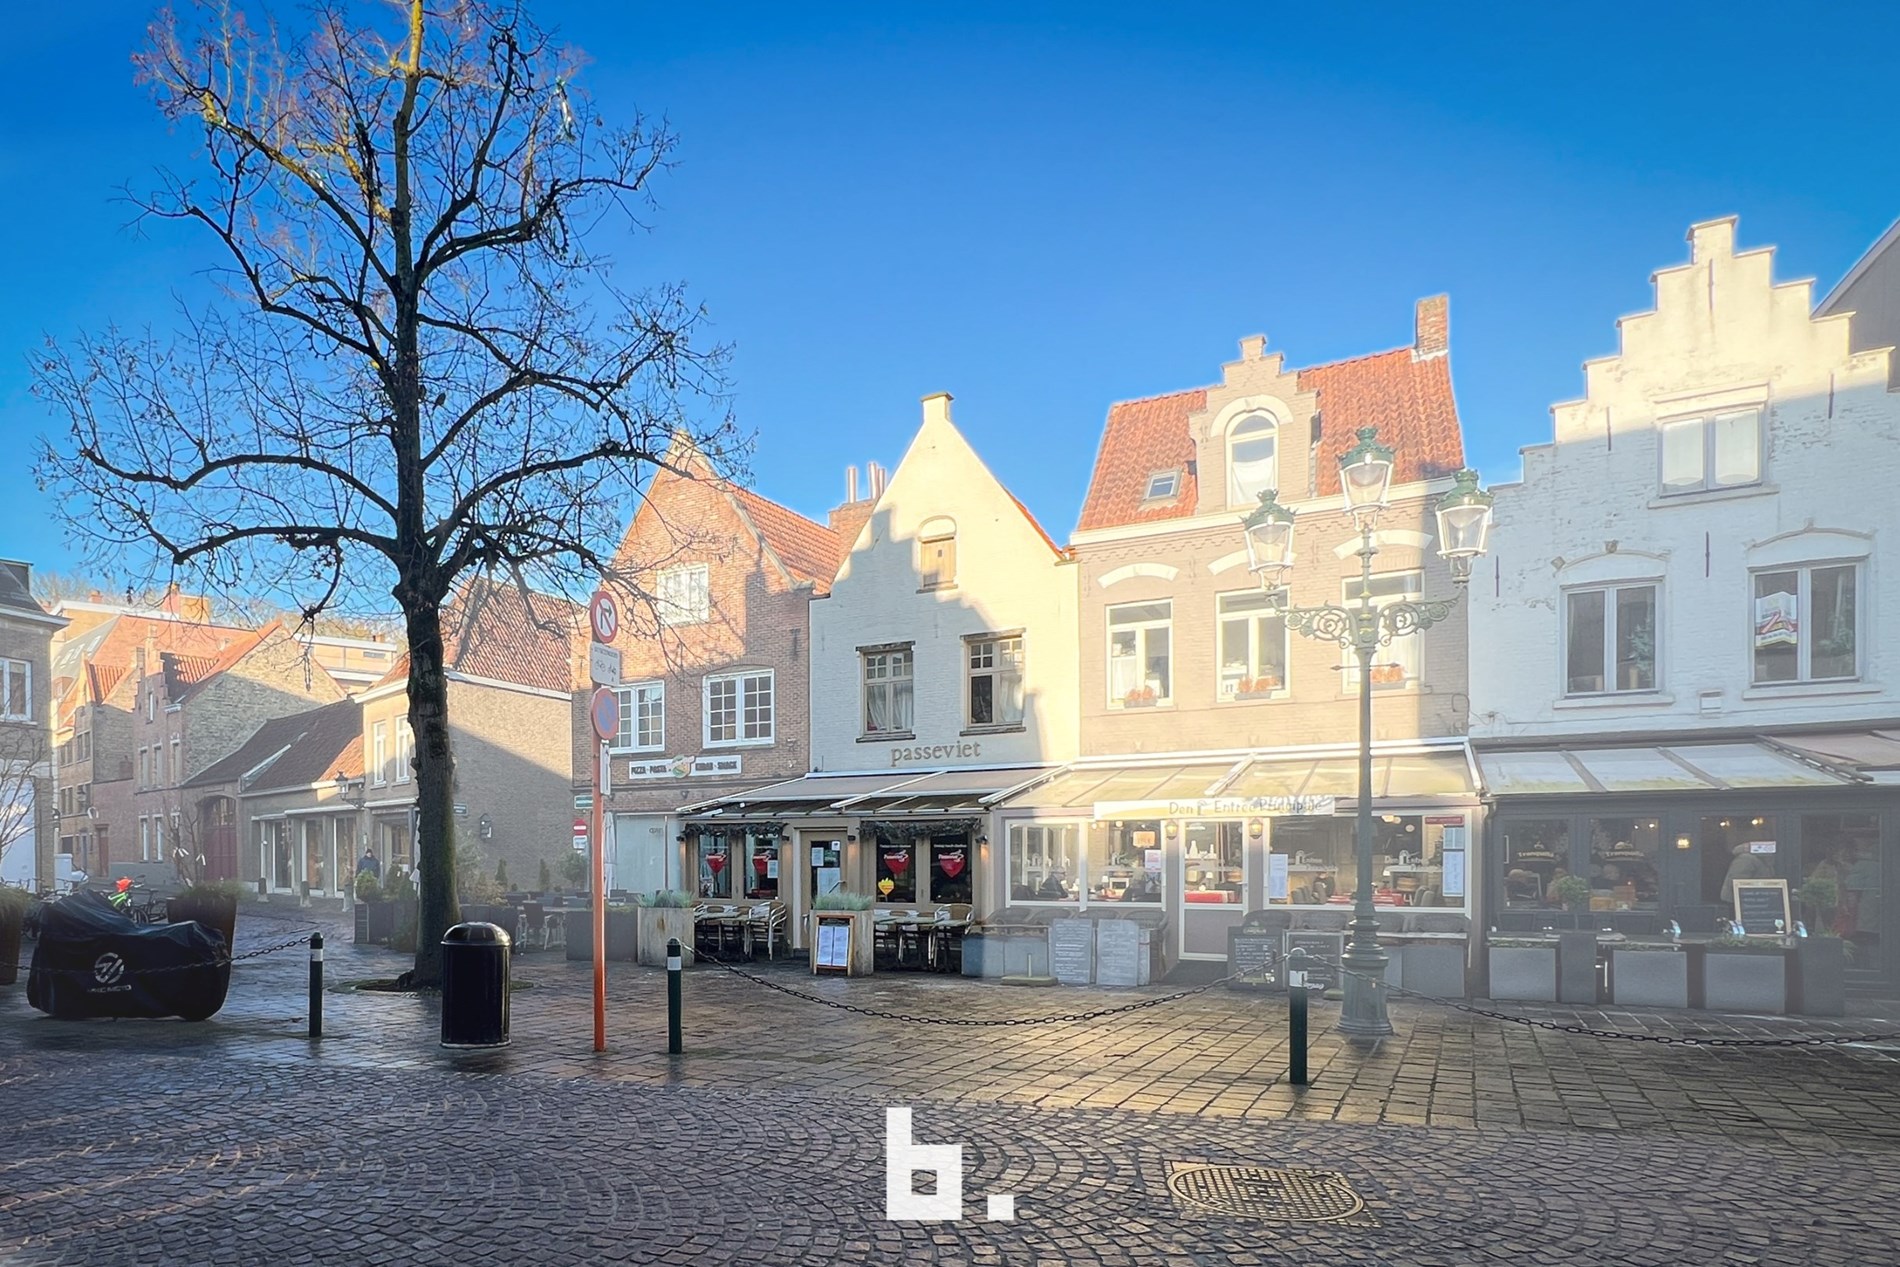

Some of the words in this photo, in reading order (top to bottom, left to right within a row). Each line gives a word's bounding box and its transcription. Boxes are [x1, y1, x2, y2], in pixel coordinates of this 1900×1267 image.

[891, 740, 981, 767] passeviet
[631, 766, 646, 775] PIZZA
[1169, 801, 1194, 815] Den
